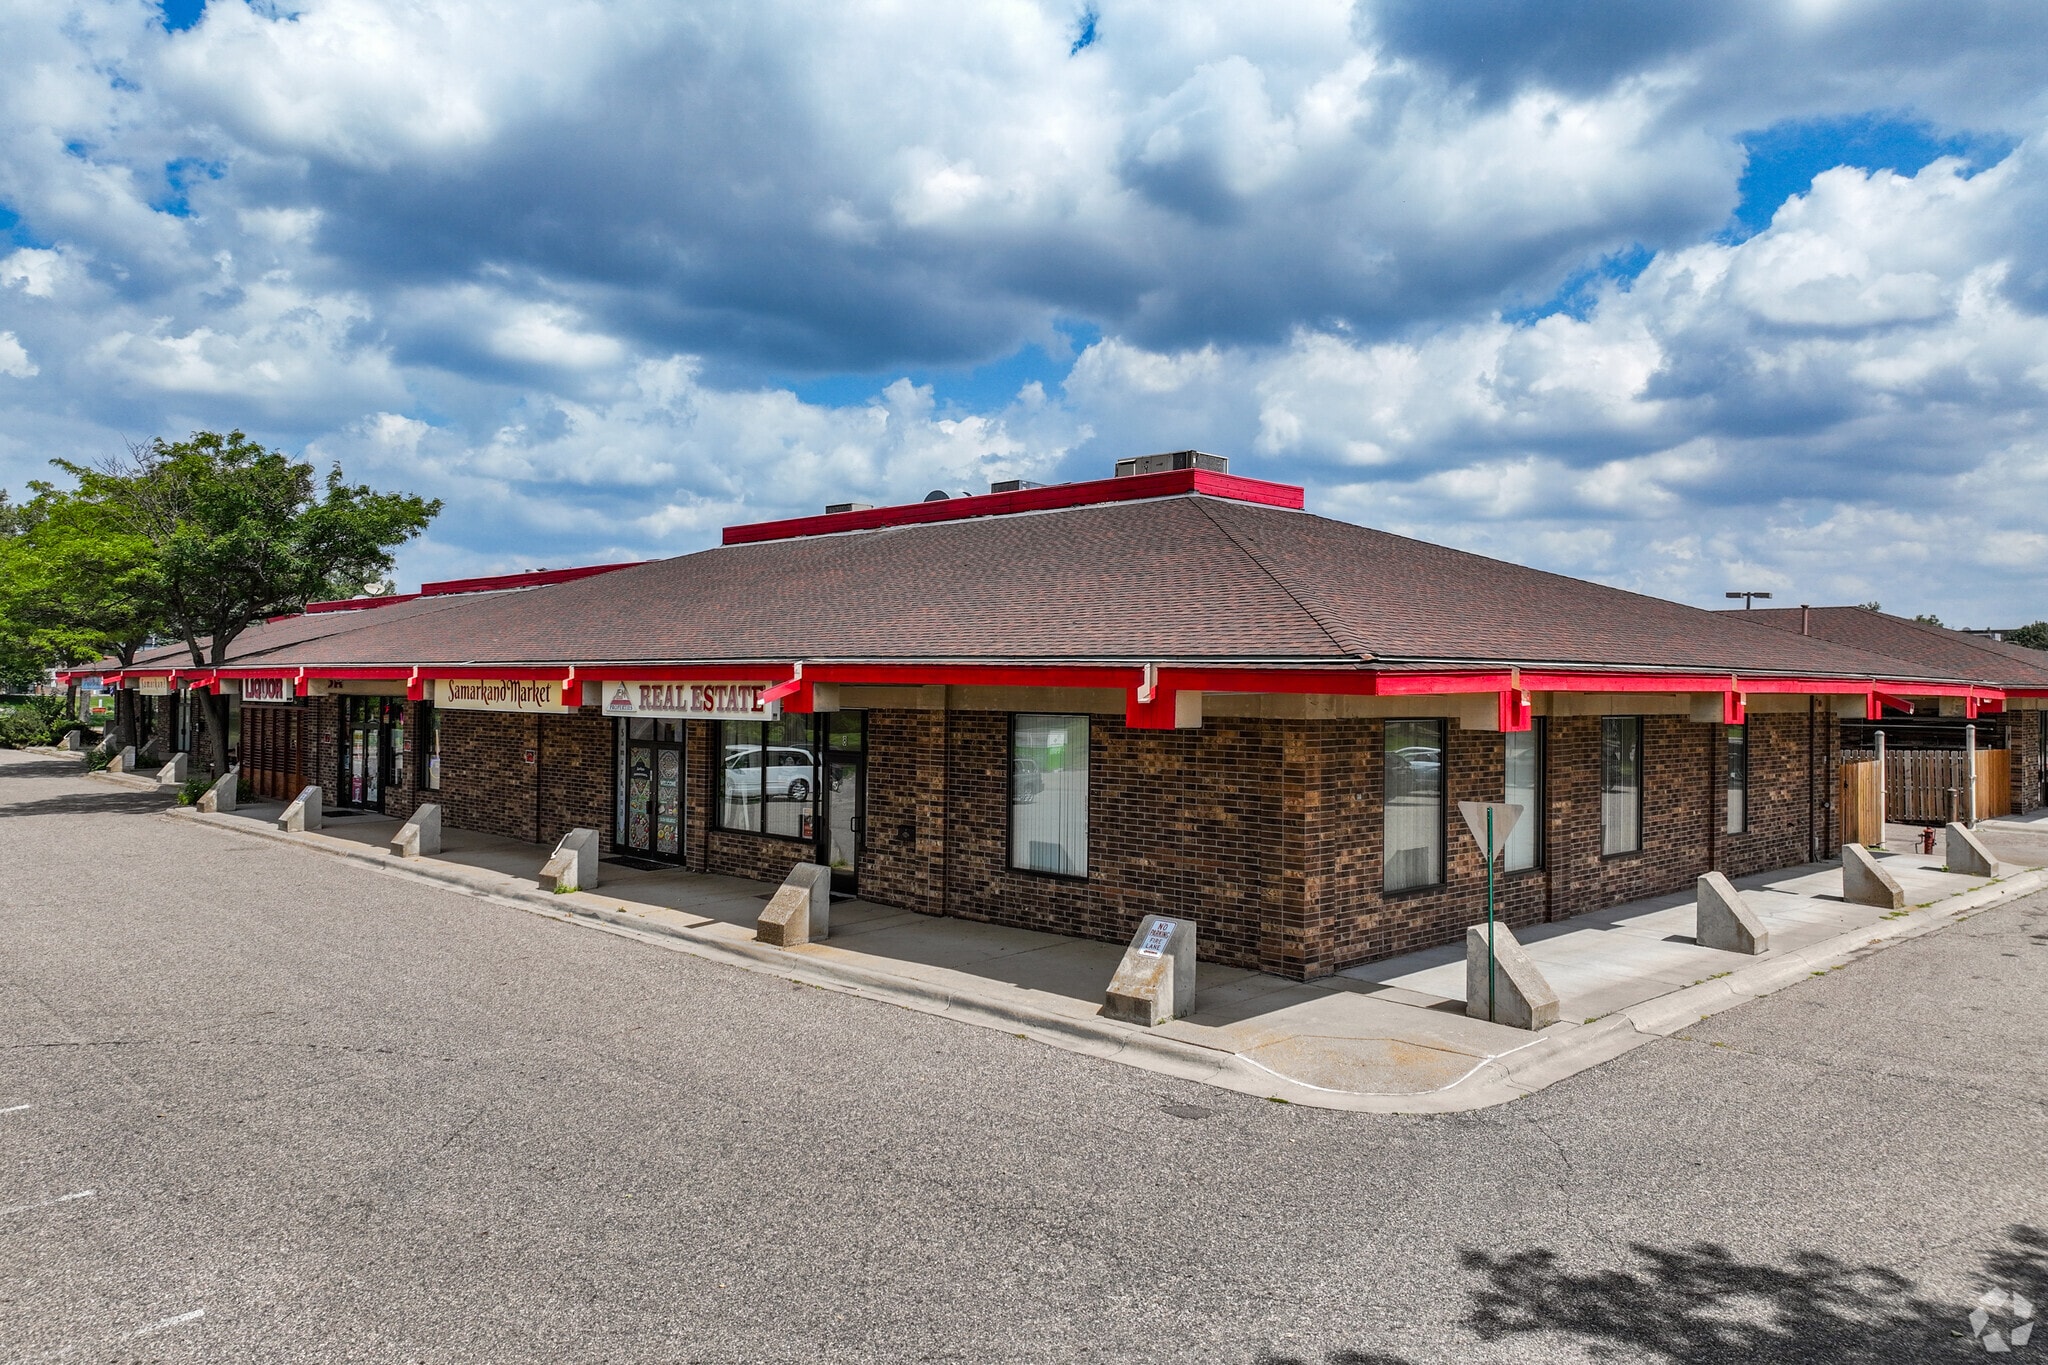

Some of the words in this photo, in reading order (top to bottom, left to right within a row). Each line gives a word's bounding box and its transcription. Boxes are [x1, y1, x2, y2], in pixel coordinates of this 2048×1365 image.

[244, 678, 283, 699] LIQUOR
[448, 680, 506, 705] Samarkand
[507, 680, 552, 708] Market
[639, 685, 688, 712] REAL
[690, 685, 766, 713] ESTATE
[1158, 922, 1168, 930] NO
